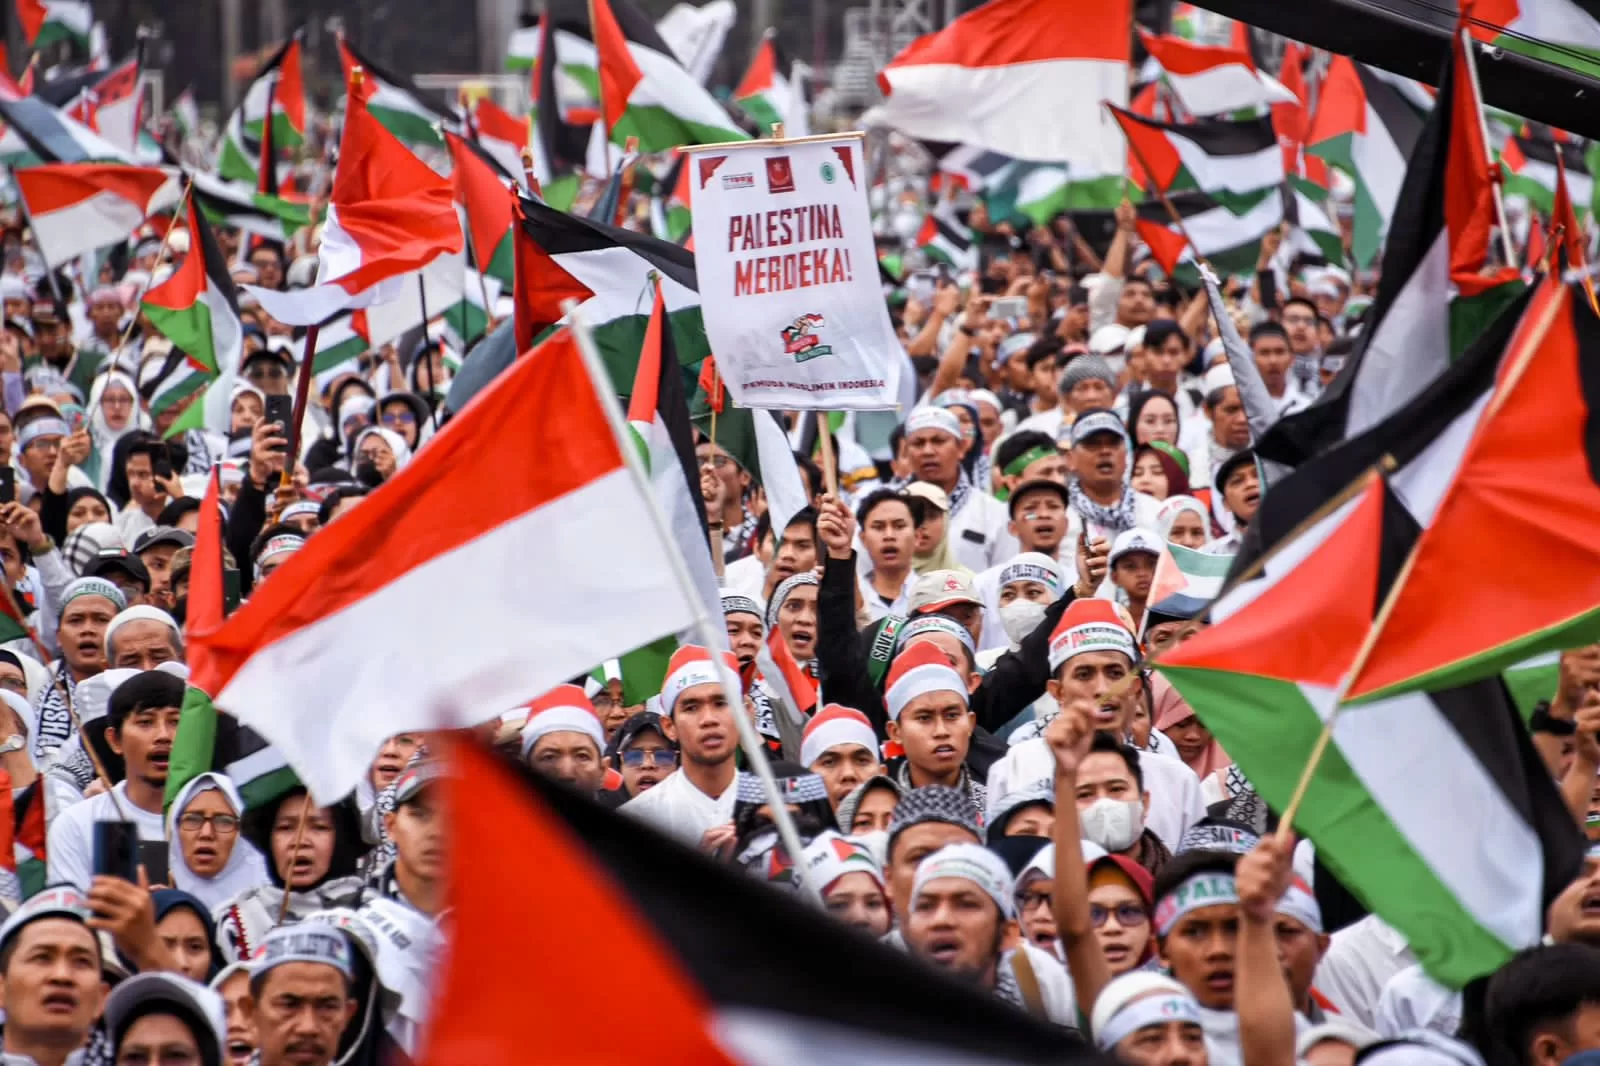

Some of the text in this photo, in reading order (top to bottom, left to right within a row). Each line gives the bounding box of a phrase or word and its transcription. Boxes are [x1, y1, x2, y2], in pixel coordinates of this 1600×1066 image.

[728, 204, 843, 252] PALESTINA
[734, 248, 853, 296] MERDEKA!
[787, 381, 836, 391] MUSLIMIN
[839, 379, 885, 389] INDONESIA
[870, 631, 896, 661] SAVE
